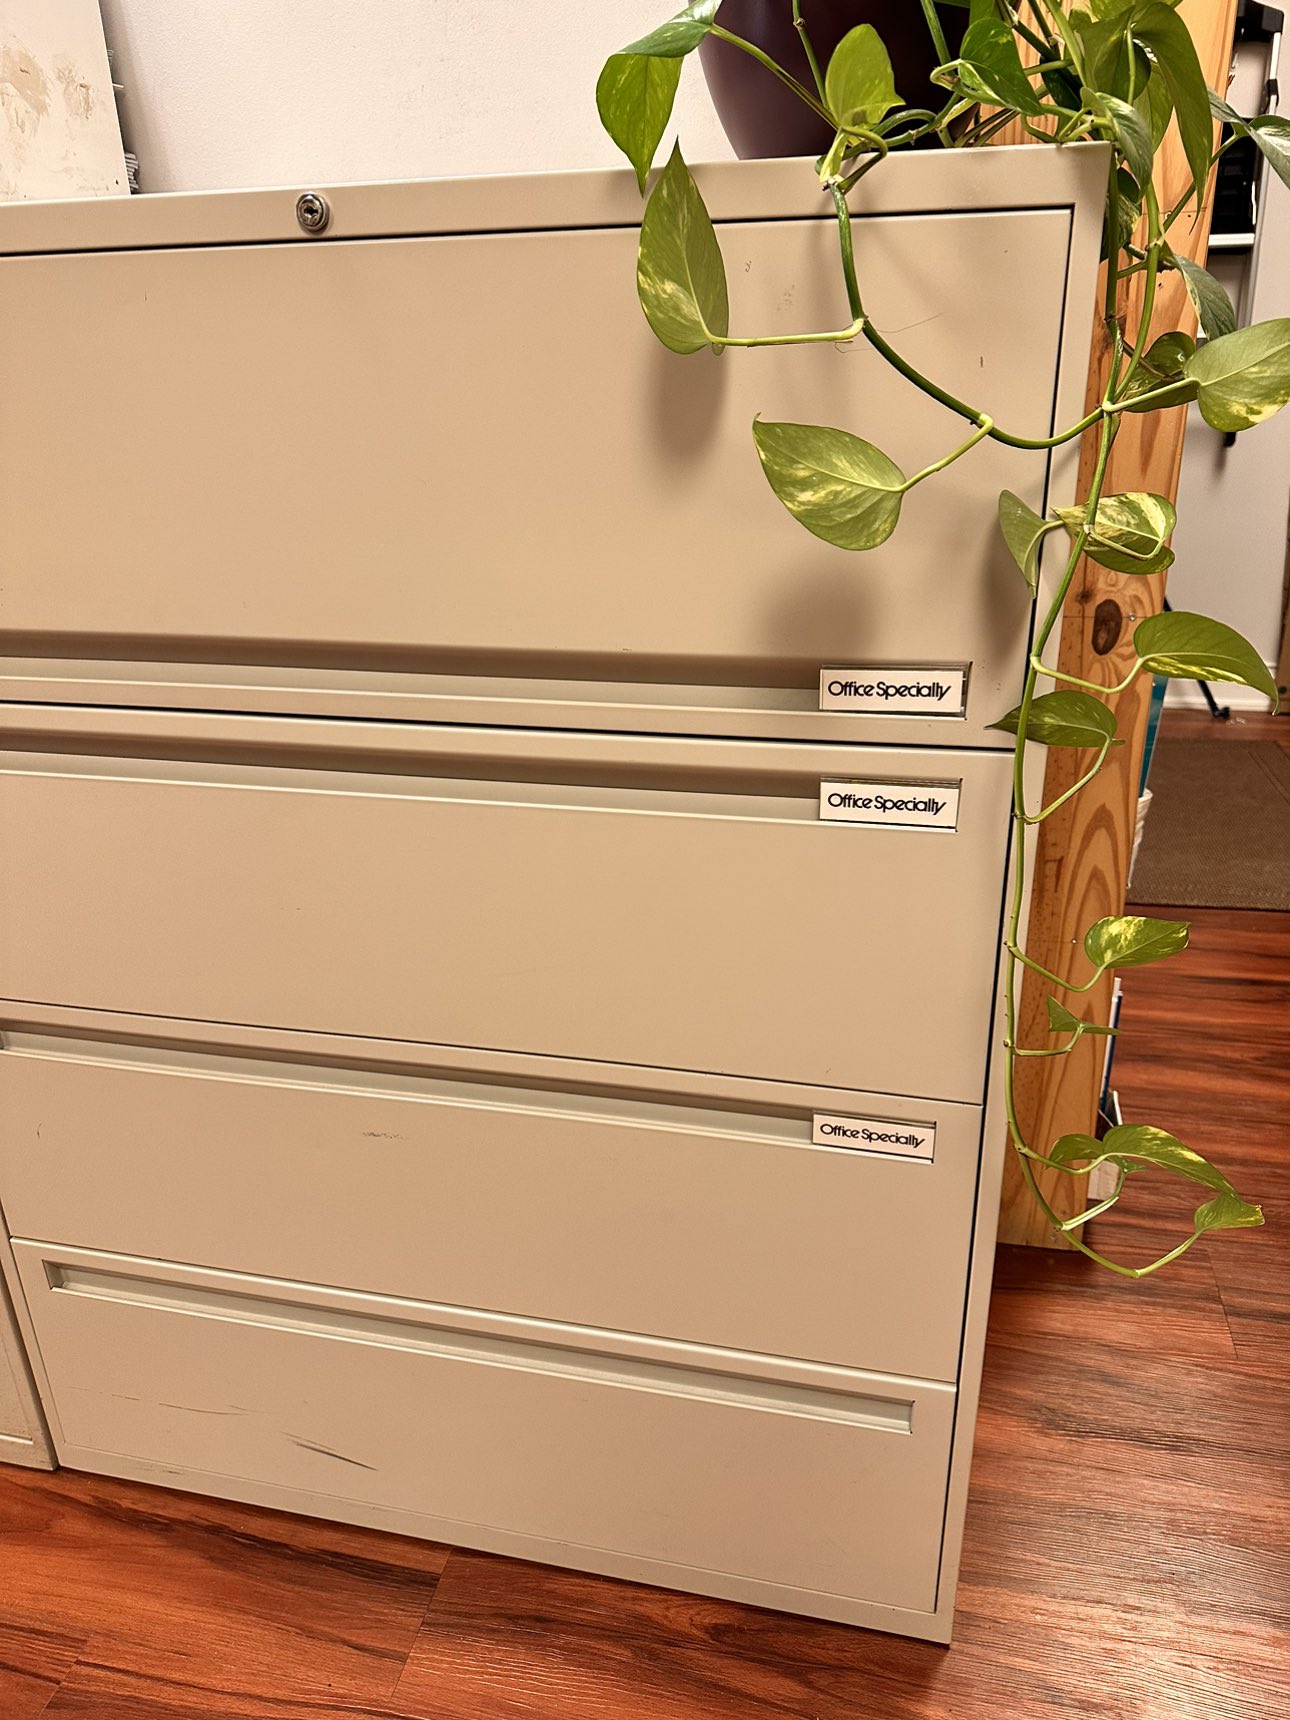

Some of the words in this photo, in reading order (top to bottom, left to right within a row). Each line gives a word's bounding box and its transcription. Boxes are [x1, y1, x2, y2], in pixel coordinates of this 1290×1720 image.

[828, 681, 875, 697] Office
[828, 793, 873, 809] Office
[820, 1123, 860, 1139] Office
